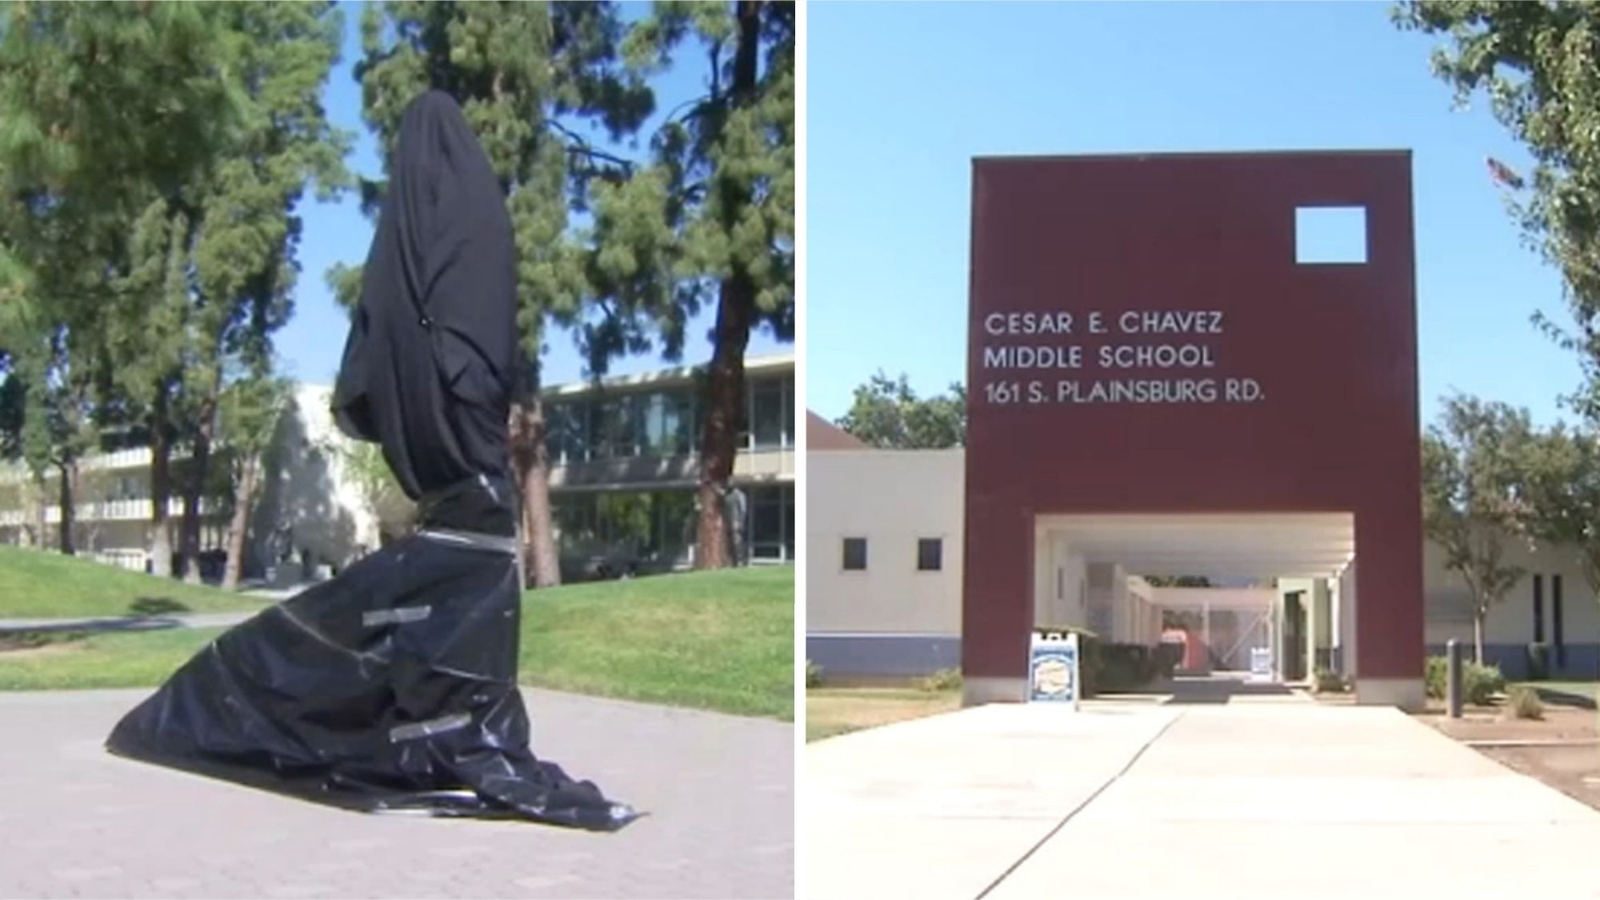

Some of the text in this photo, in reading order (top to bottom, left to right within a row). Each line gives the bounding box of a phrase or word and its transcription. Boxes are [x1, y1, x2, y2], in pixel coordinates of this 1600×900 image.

[985, 311, 1223, 334] CESAR E. CHAVEZ
[984, 345, 1214, 368] MIDDLE SCHOOL
[985, 379, 1265, 403] 161 S. PLAINSBURG RD.
